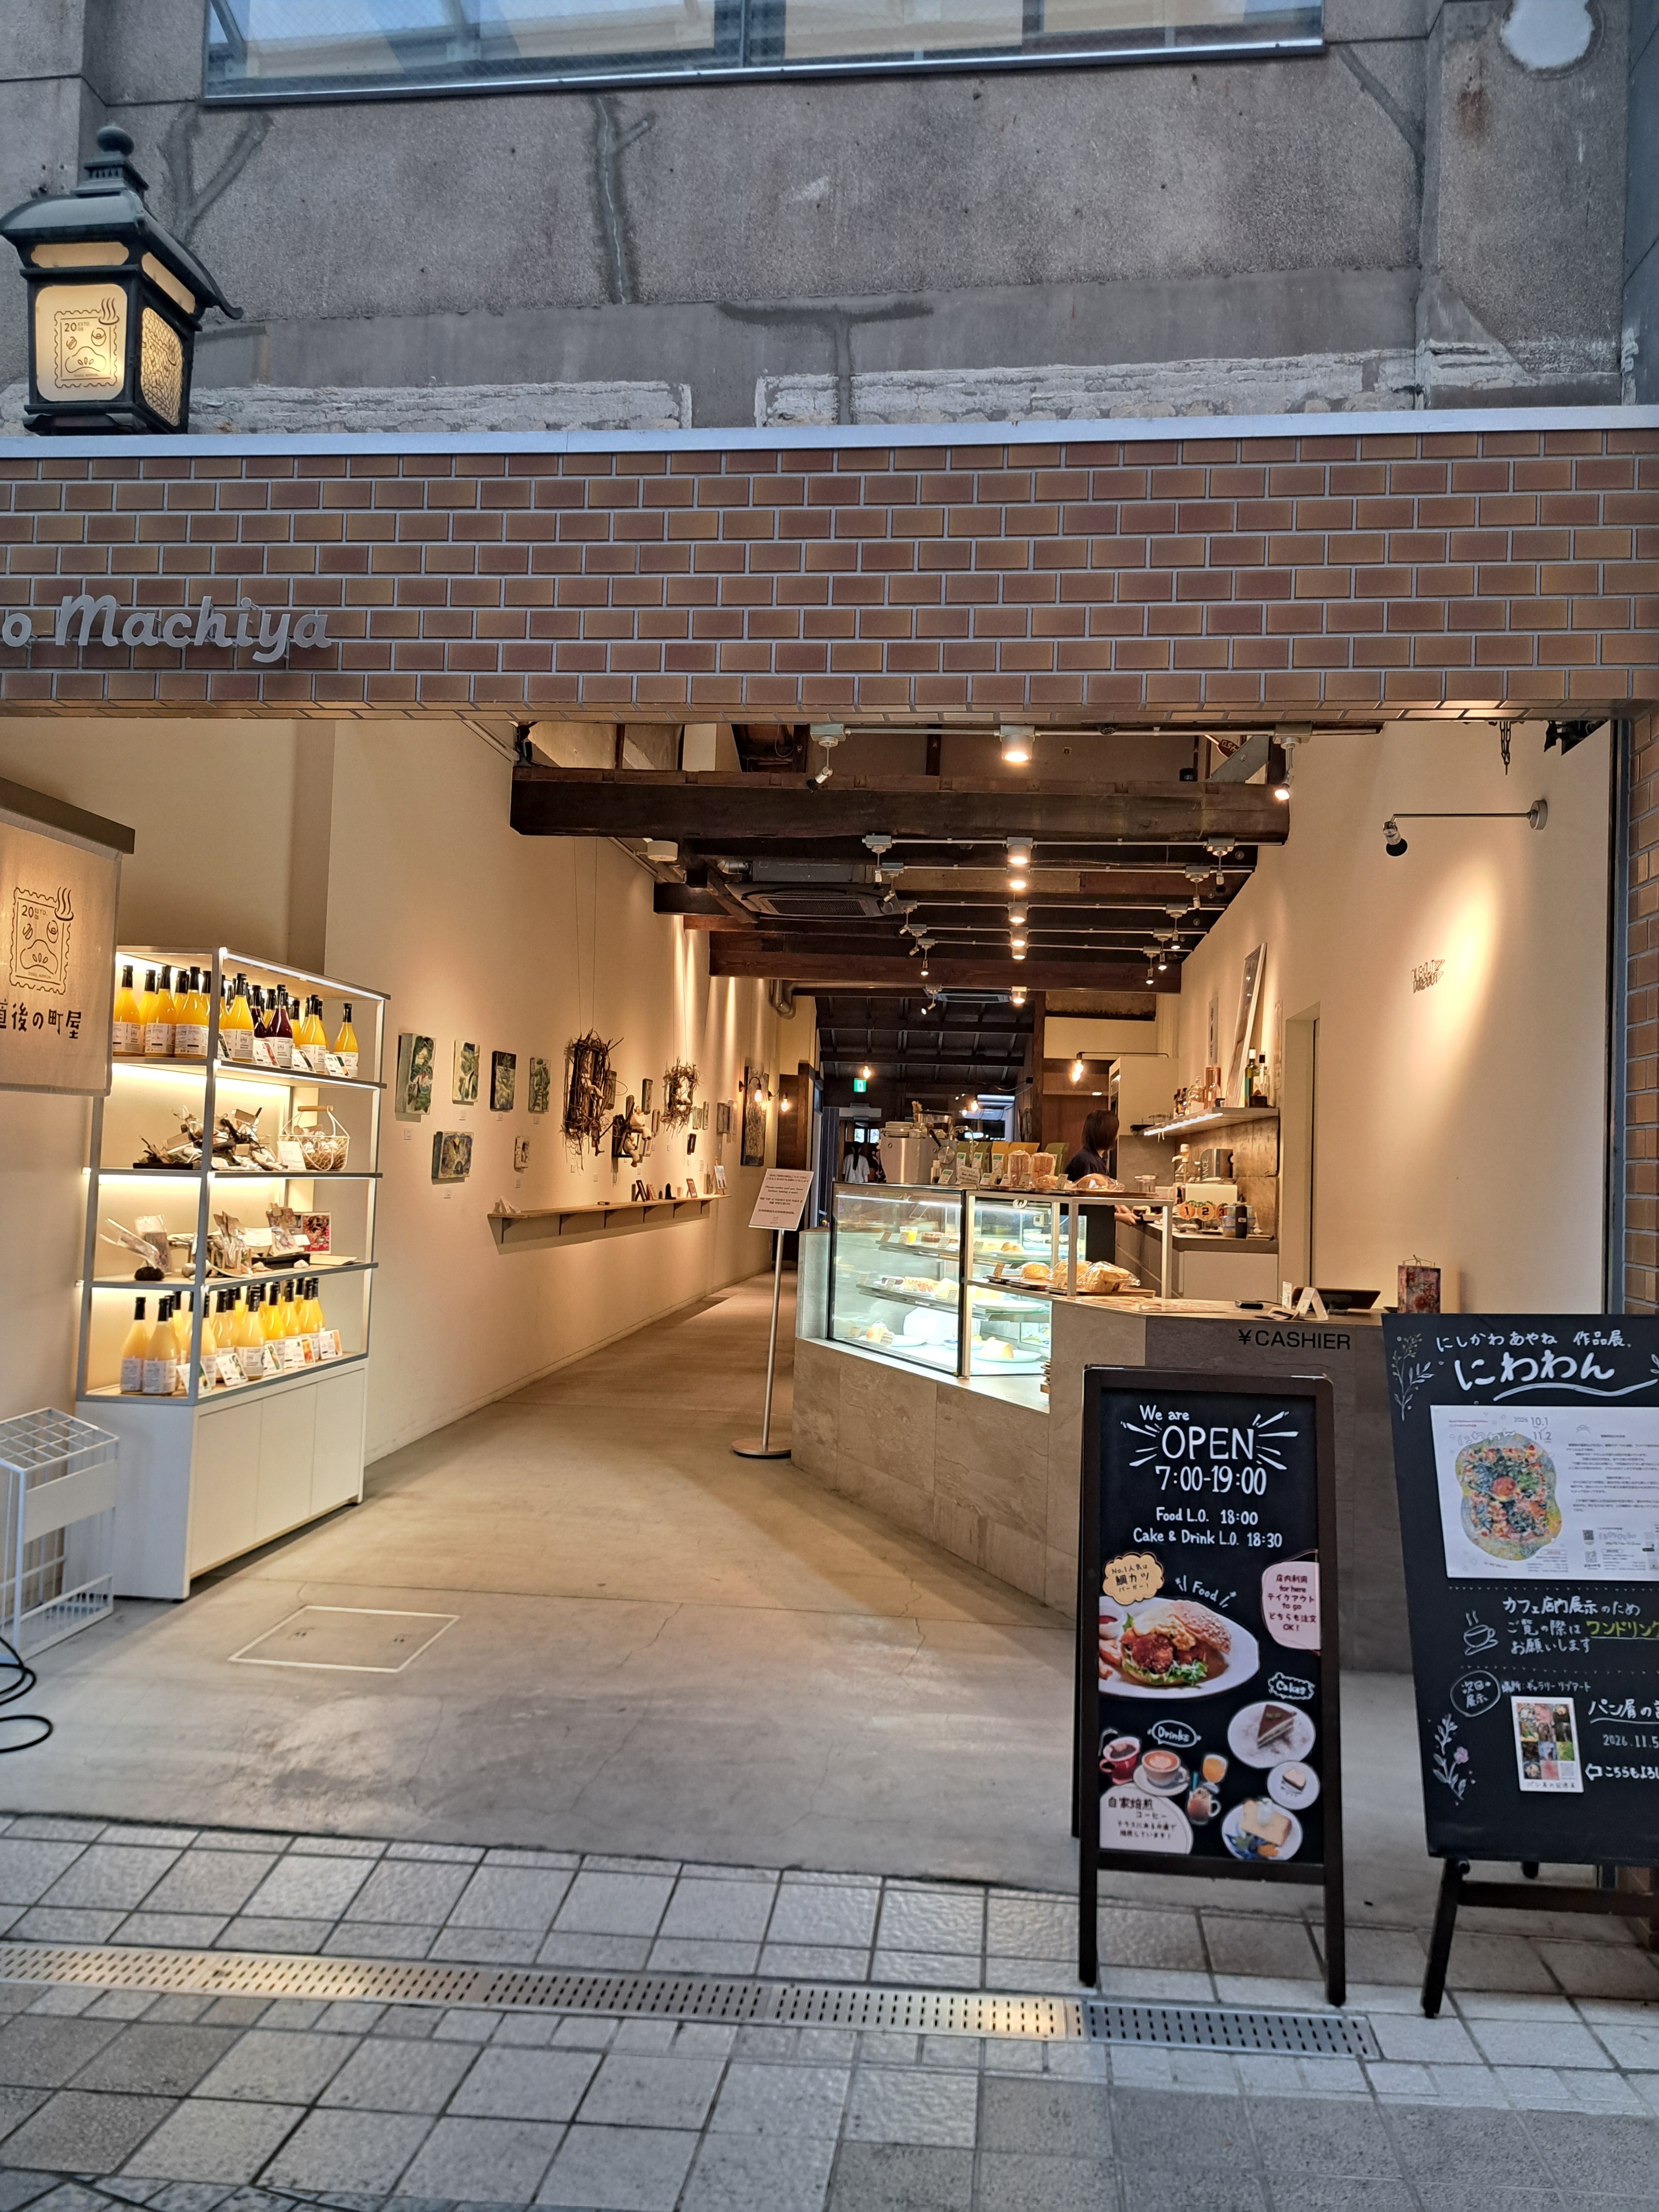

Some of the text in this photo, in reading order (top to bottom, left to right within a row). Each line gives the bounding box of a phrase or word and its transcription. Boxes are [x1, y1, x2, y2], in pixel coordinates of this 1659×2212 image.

[65, 322, 77, 332] 20
[2, 595, 332, 663] o Machiya
[22, 905, 34, 918] 20
[1454, 1349, 1615, 1391] にわわん
[1139, 1405, 1190, 1421] We are
[1162, 1425, 1254, 1460] OPEN
[1155, 1465, 1267, 1495] 7:00-19:00
[1156, 1506, 1259, 1525] Food L.O. 18:00
[1133, 1527, 1283, 1548] Cake & Drink L.O. 18:30
[1192, 1581, 1219, 1602] Food
[1268, 1593, 1315, 1603] テイクアウト
[1511, 1637, 1591, 1656] お願いします
[1158, 1725, 1190, 1742] Drinks
